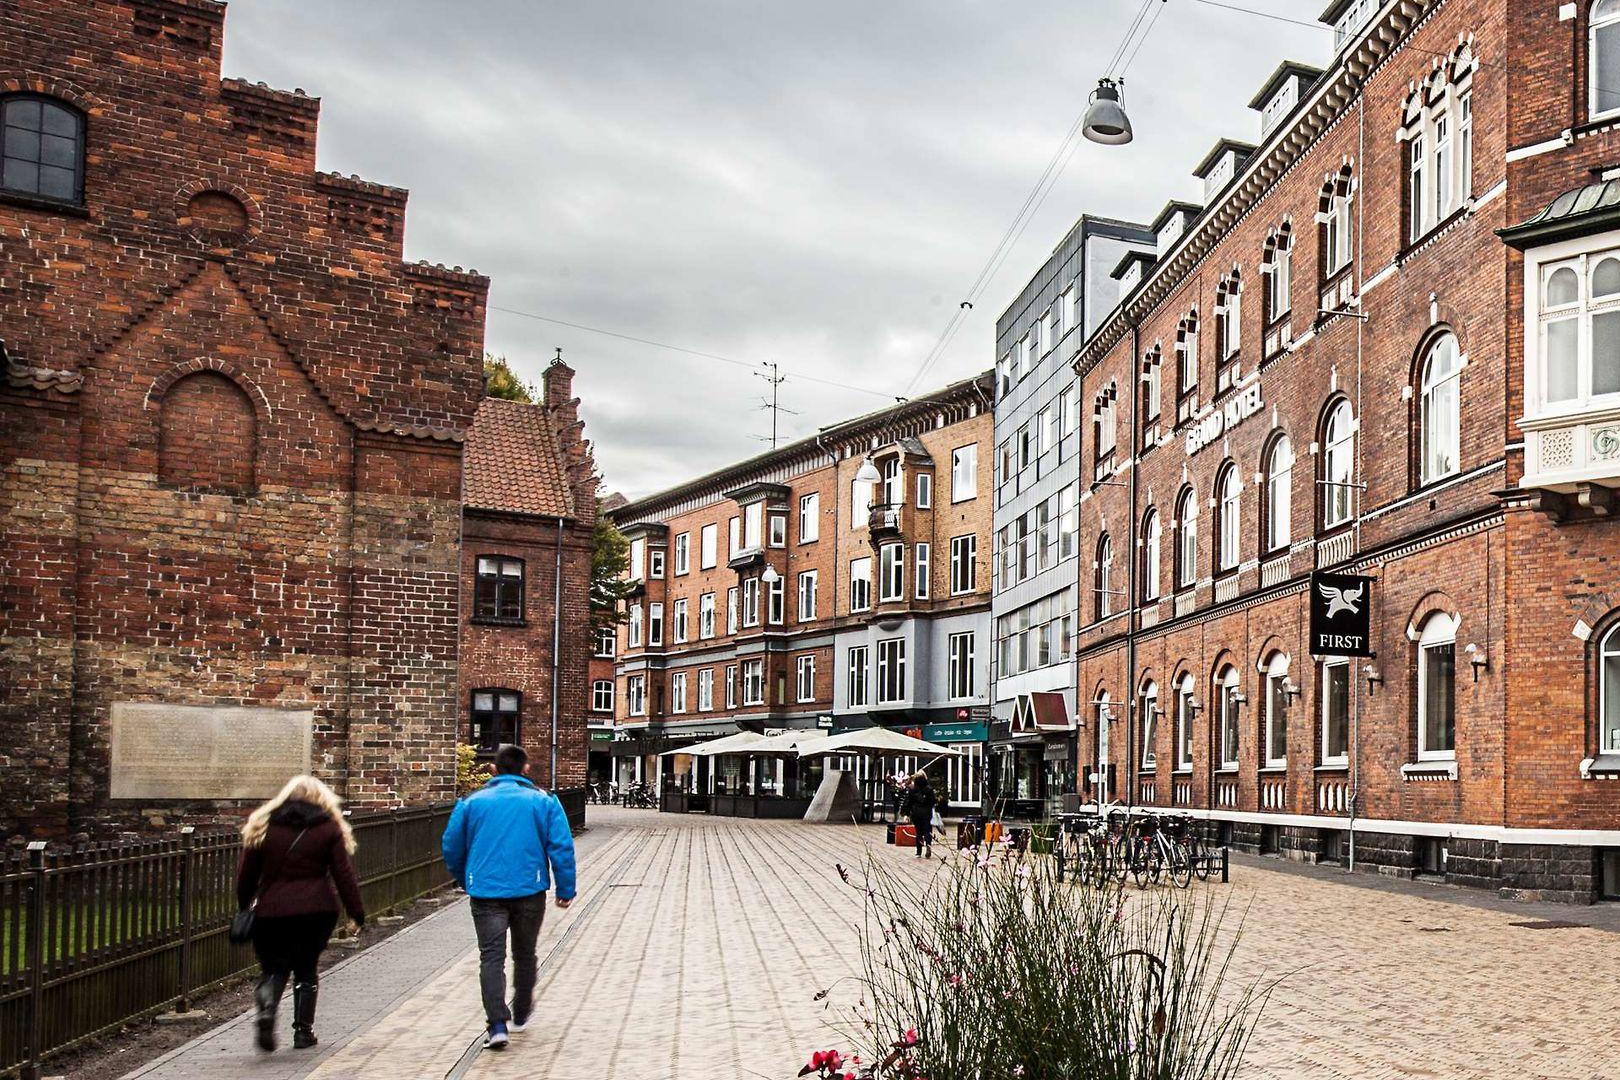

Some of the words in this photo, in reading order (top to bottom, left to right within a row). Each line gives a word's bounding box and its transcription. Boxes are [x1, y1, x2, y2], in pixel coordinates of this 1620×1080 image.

[1185, 410, 1224, 457] GRAND
[1224, 382, 1265, 431] HOTEL
[1319, 633, 1362, 649] FIRST
